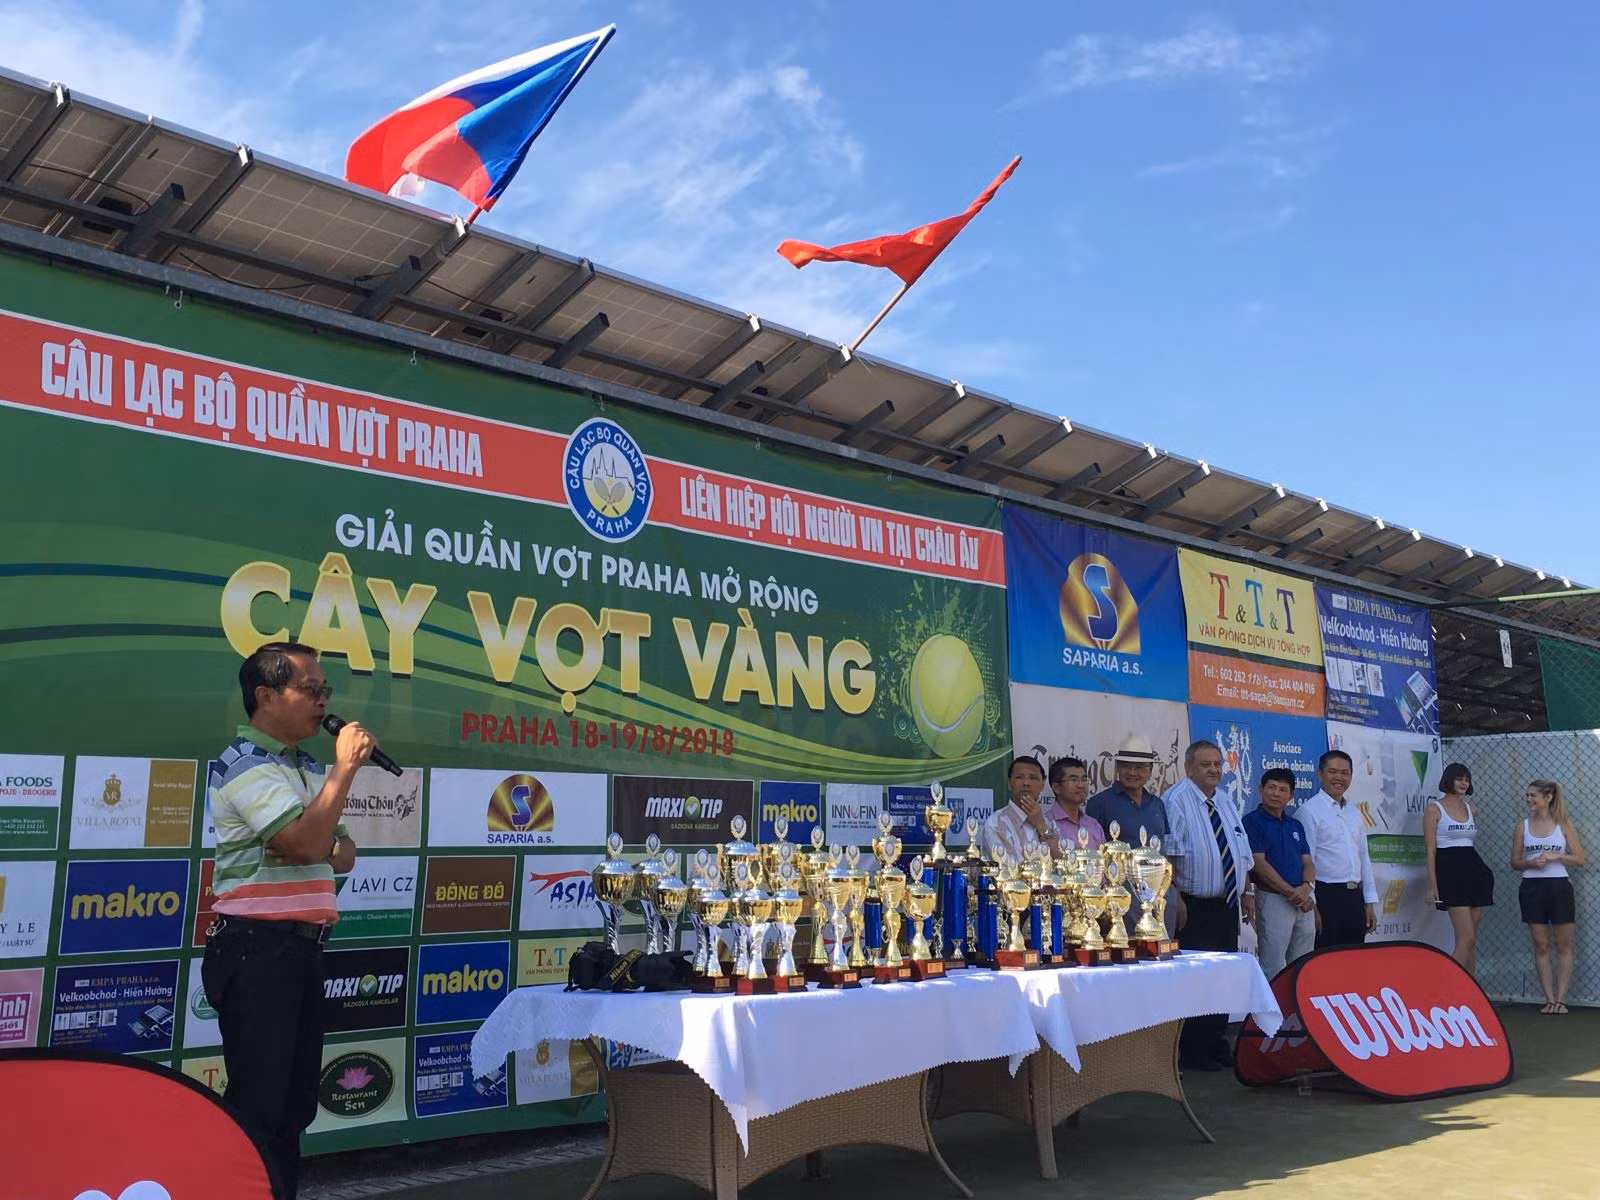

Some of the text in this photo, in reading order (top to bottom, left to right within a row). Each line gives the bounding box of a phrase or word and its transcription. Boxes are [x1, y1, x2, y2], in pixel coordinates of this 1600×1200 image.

[41, 338, 484, 478] CÂU LẠC BỘ QUẦN VỢT PRAHA
[587, 509, 632, 533] PRAHA
[680, 474, 979, 570] LIÊN HIỆP HỘI NGƯỜI VN TẠI CHÂU ÂU
[335, 508, 819, 617] GIẢI QUẦN VỢT PRAHA MỞ RỘNG
[1348, 597, 1369, 615] EMPA
[1371, 602, 1397, 621] PRAHA
[220, 552, 876, 716] CÂY VỢT VÀNG
[1320, 614, 1375, 643] Velkoobchod
[1062, 646, 1143, 675] SAPARIA a.s.
[1220, 667, 1233, 681] 602
[1217, 684, 1239, 699] Email:
[462, 713, 735, 756] PRAHA 18-19/8/2018
[1273, 741, 1302, 754] Asociace
[6, 776, 53, 787] FOODS
[645, 797, 723, 818] MAXI TIP
[762, 799, 818, 823] makro
[966, 807, 992, 820] ACVN
[77, 815, 143, 827] VILLA ROYAL
[487, 833, 555, 844] SAPARIA a.s.
[351, 877, 413, 893] LAVI CZ
[435, 881, 505, 901] ĐÔNG ĐÔ
[551, 880, 596, 907] ASIA
[71, 885, 180, 920] makro
[17, 922, 36, 933] LE
[116, 975, 144, 986] PRAHA
[422, 964, 504, 996] makro
[609, 961, 628, 980] Nikon
[377, 974, 404, 995] TIP
[59, 988, 118, 1003] Velkoobchod
[1309, 986, 1495, 1060] Wilson
[418, 1055, 462, 1067] Velkoobchod
